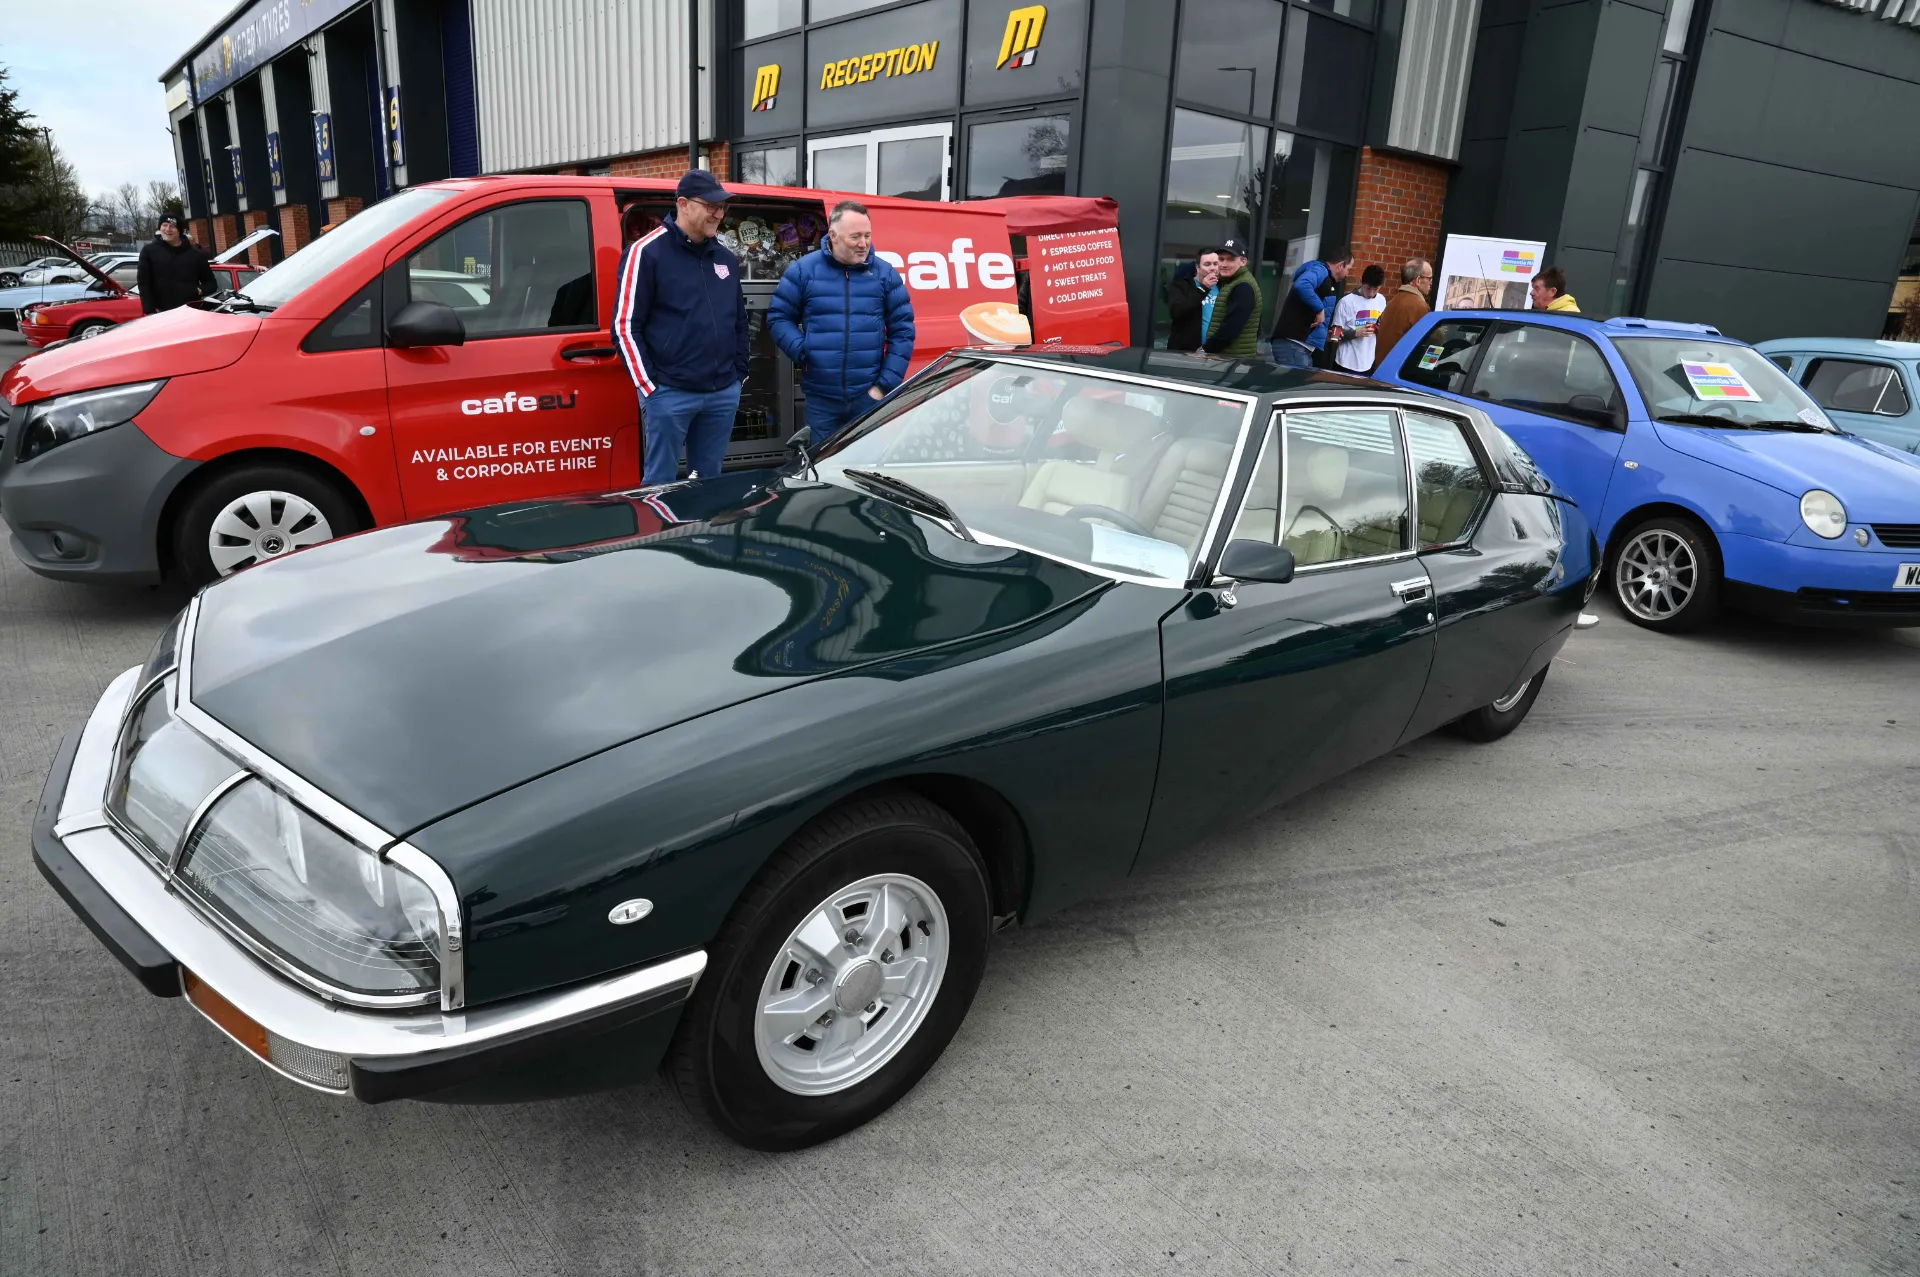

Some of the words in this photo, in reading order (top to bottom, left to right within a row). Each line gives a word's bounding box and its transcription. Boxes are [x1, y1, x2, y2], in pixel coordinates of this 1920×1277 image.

[262, 0, 290, 43] TYRES
[820, 40, 940, 90] RECEPTION
[390, 97, 399, 130] 6
[322, 123, 328, 151] 5
[273, 139, 279, 163] 4
[1050, 244, 1086, 257] ESPRESSO
[1087, 240, 1113, 251] COFFEE
[1052, 262, 1067, 272] HOT
[1069, 261, 1075, 269] &
[1076, 258, 1094, 268] COLD
[1096, 256, 1114, 265] FOOD
[1054, 275, 1079, 287] SWEET
[1081, 271, 1107, 283] TREATS
[1056, 293, 1076, 303] COLD
[1077, 288, 1103, 300] DRINKS
[1690, 376, 1729, 385] Dementia
[411, 444, 508, 464] AVAILABLE
[513, 441, 546, 456] FOR
[550, 436, 612, 453] EVENTS
[436, 468, 449, 481] &
[453, 459, 556, 479] CORPORATE
[560, 456, 597, 470] HIRE
